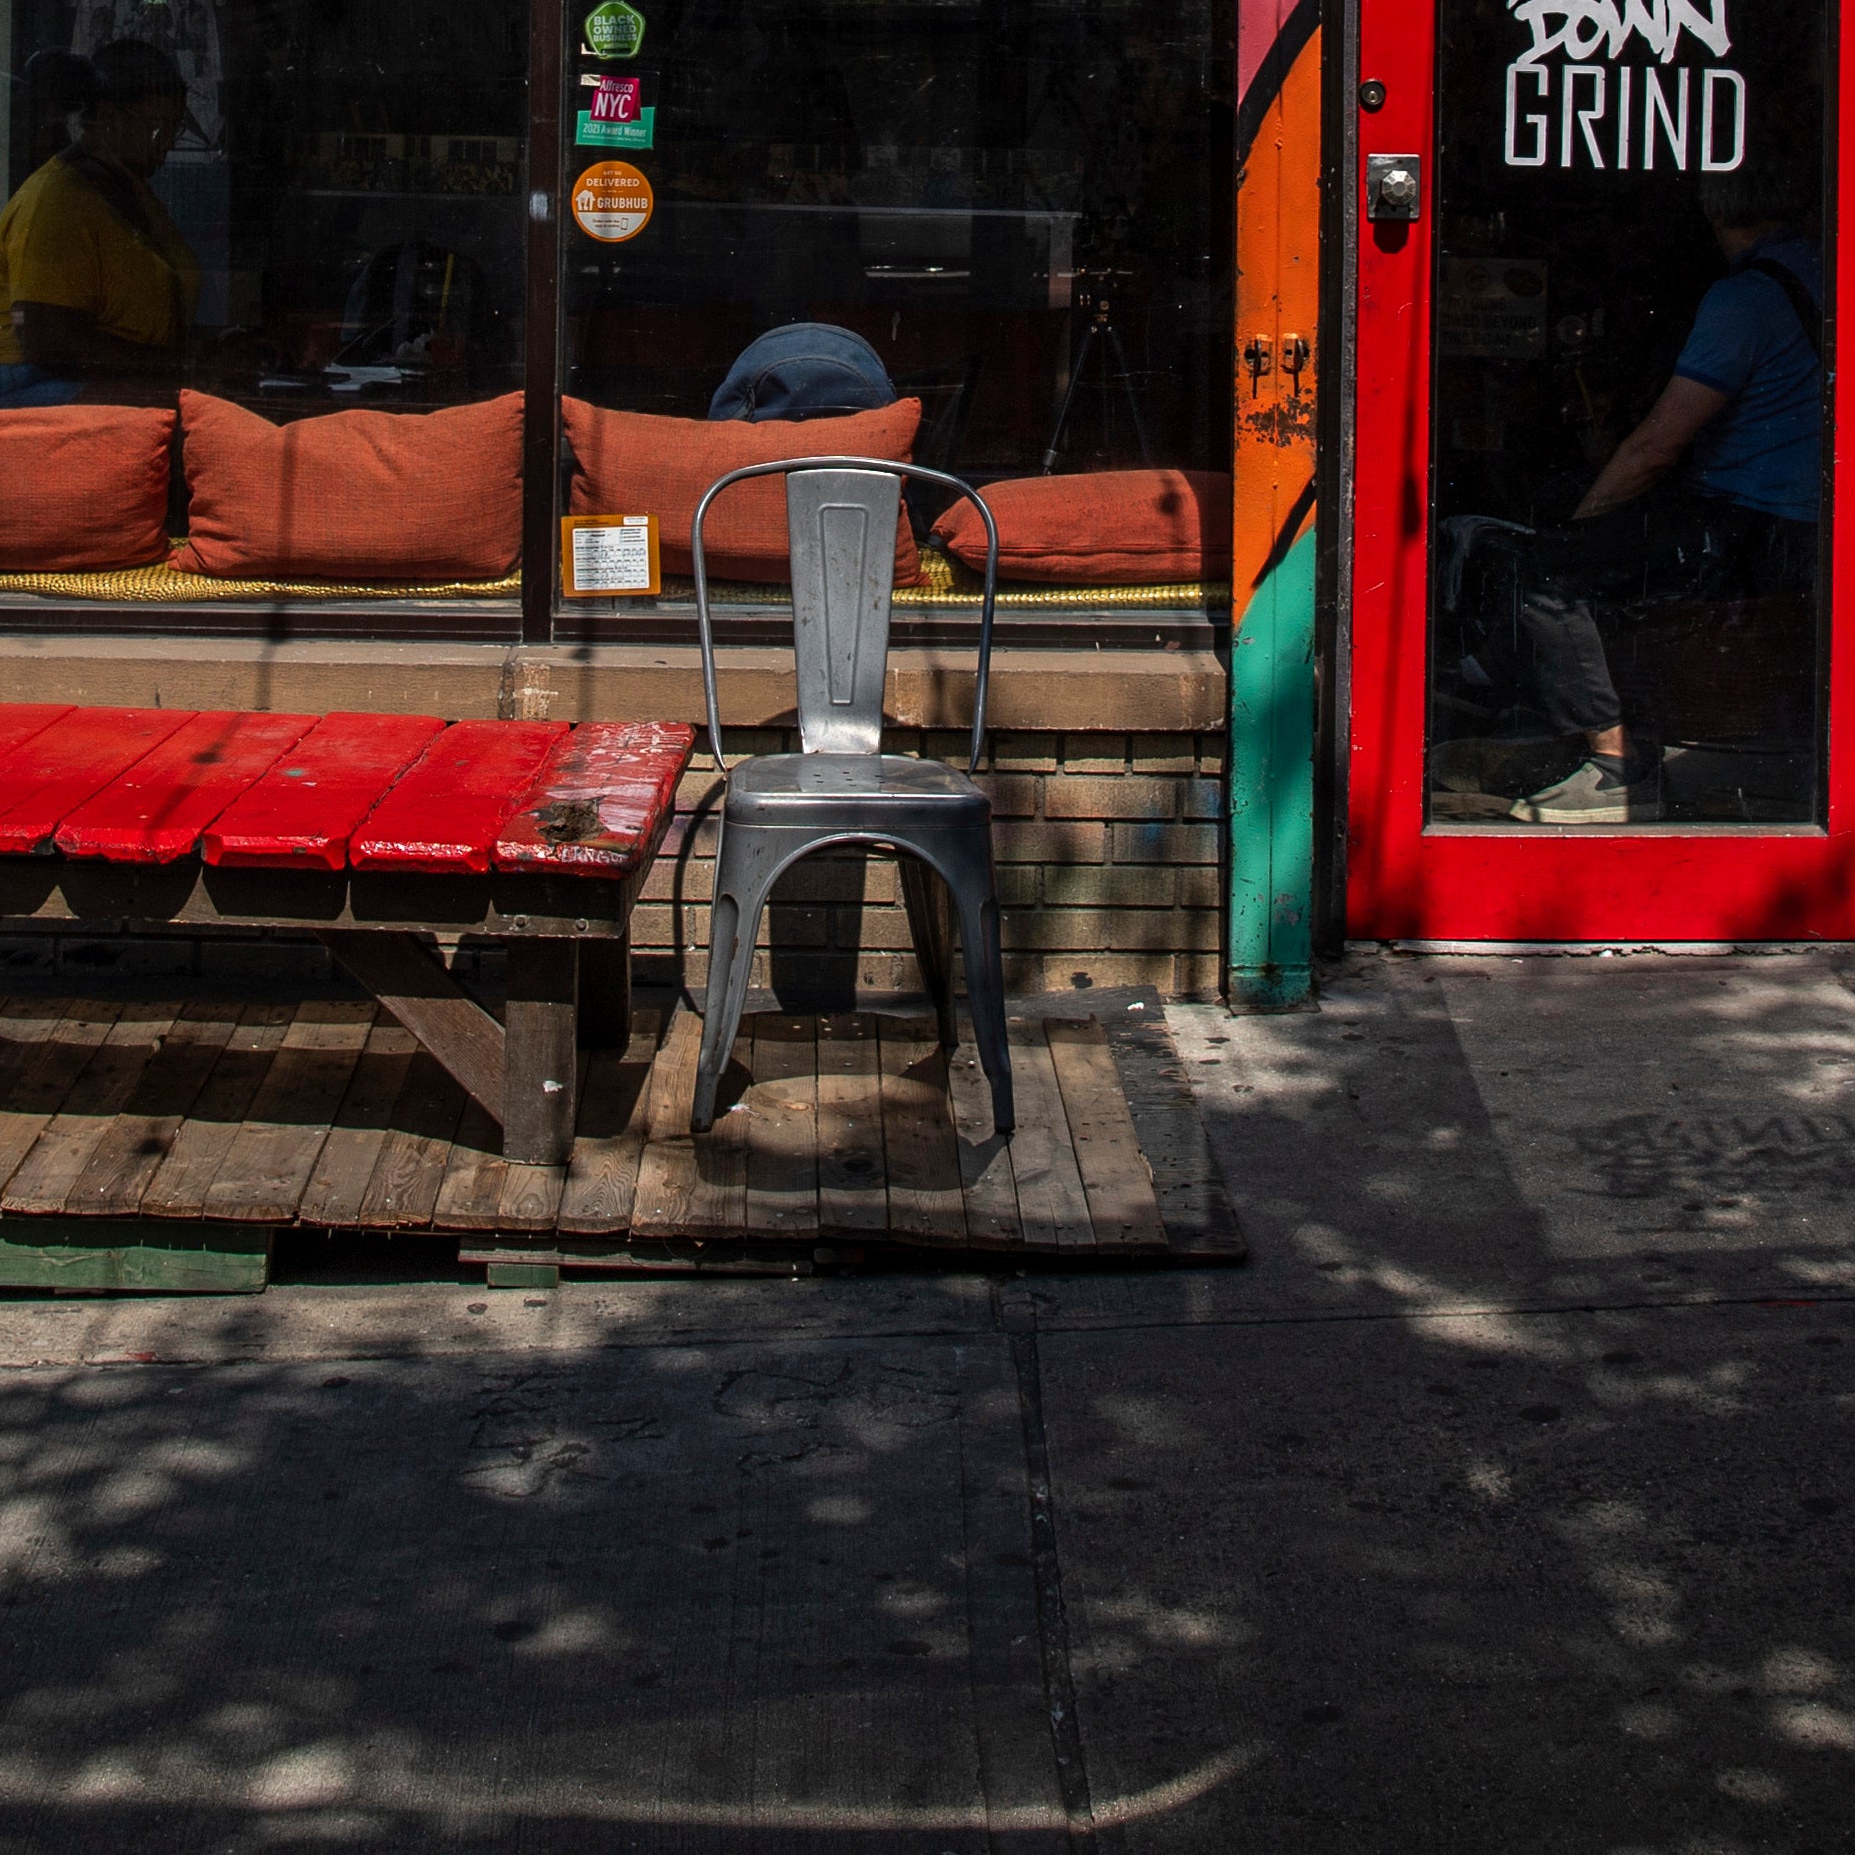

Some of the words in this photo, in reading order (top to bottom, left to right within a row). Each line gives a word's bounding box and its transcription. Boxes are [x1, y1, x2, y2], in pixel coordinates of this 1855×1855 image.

[594, 15, 635, 25] BLACK
[593, 25, 636, 34] OWNED
[593, 34, 637, 42] BUSINESS
[599, 80, 634, 93] Alfresco
[594, 93, 631, 119] NYC
[1504, 64, 1746, 171] GRIND
[583, 123, 600, 134] 2021
[601, 125, 623, 136] Award
[624, 127, 647, 138] Winner
[586, 178, 640, 187] DELIVERED
[597, 197, 648, 209] GRUBHUB
